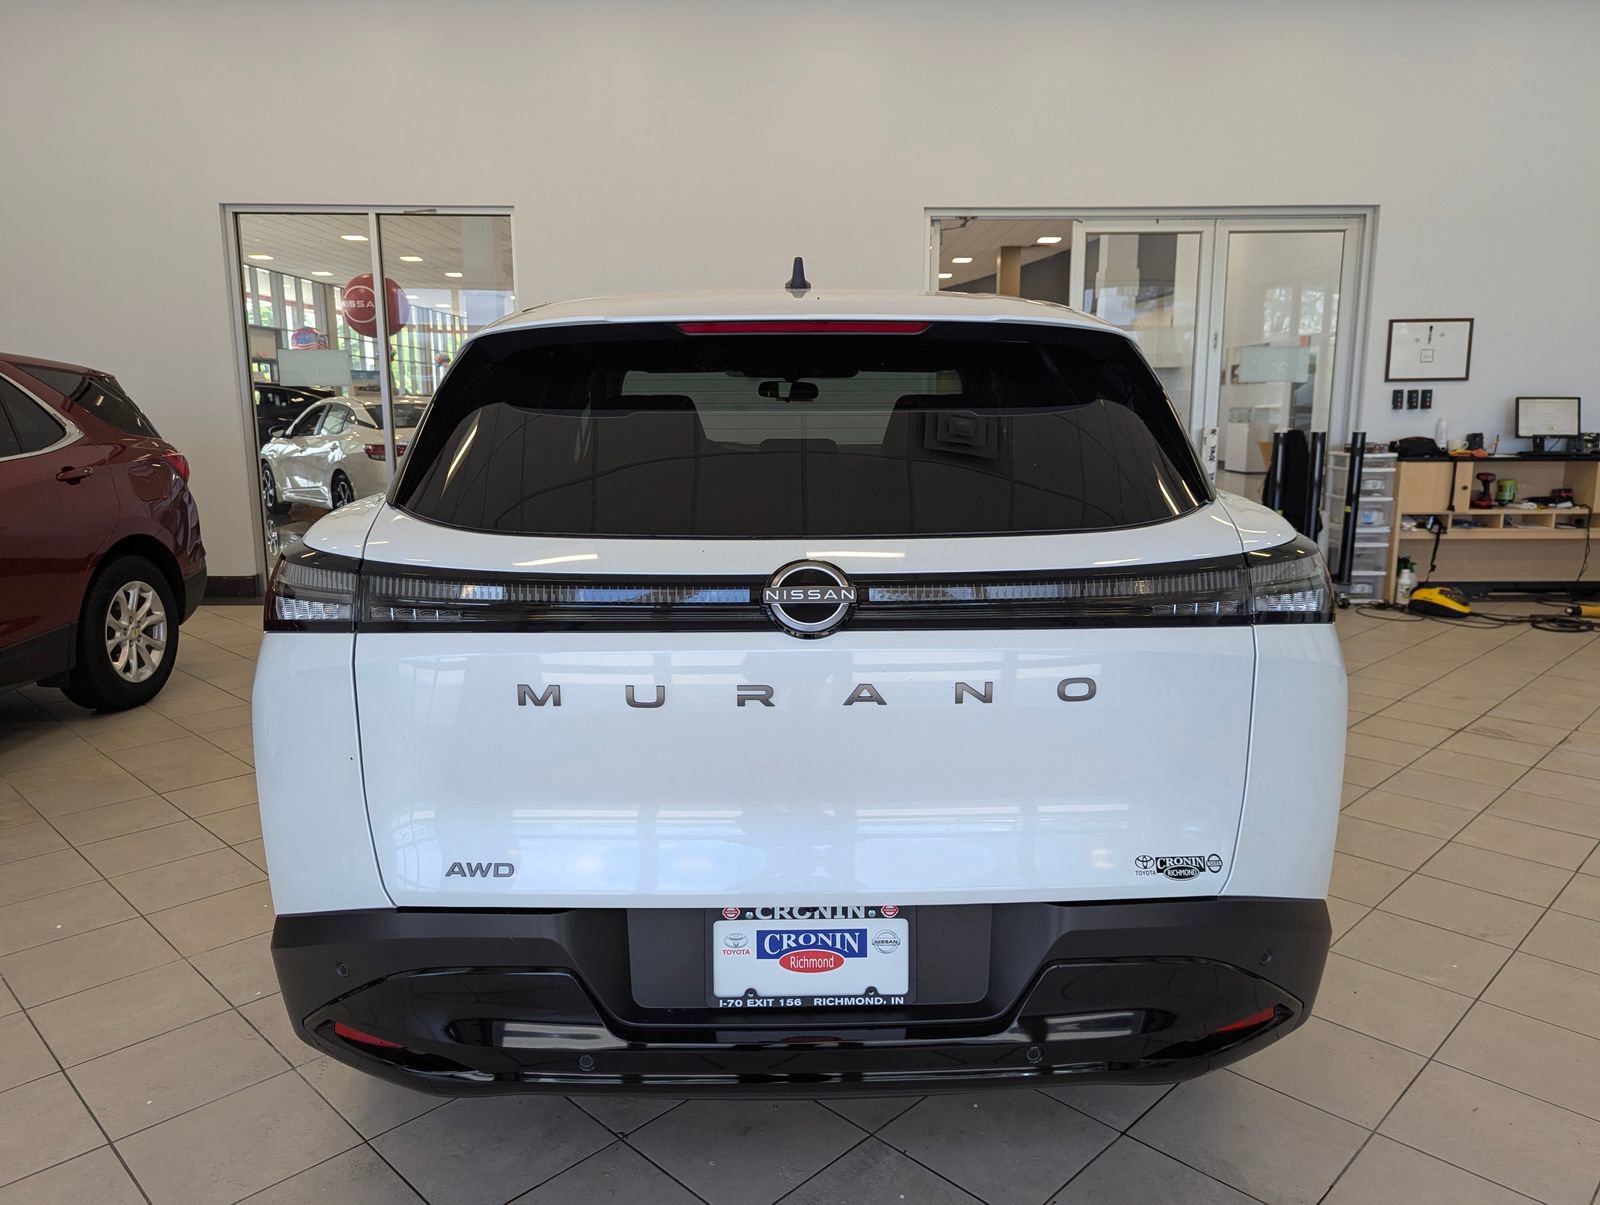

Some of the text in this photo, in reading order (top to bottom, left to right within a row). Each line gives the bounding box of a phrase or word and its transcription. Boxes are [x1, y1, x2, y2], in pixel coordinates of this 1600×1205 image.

[765, 589, 855, 600] NISSAN
[516, 677, 1097, 708] MURANO
[444, 861, 515, 878] AWD
[1157, 857, 1205, 870] CRONIN
[763, 931, 861, 955] CRONIN
[789, 955, 835, 969] Richmond
[719, 999, 743, 1007] I-70
[747, 998, 775, 1007] EXIT
[779, 998, 802, 1007] 156
[891, 996, 904, 1005] IN
